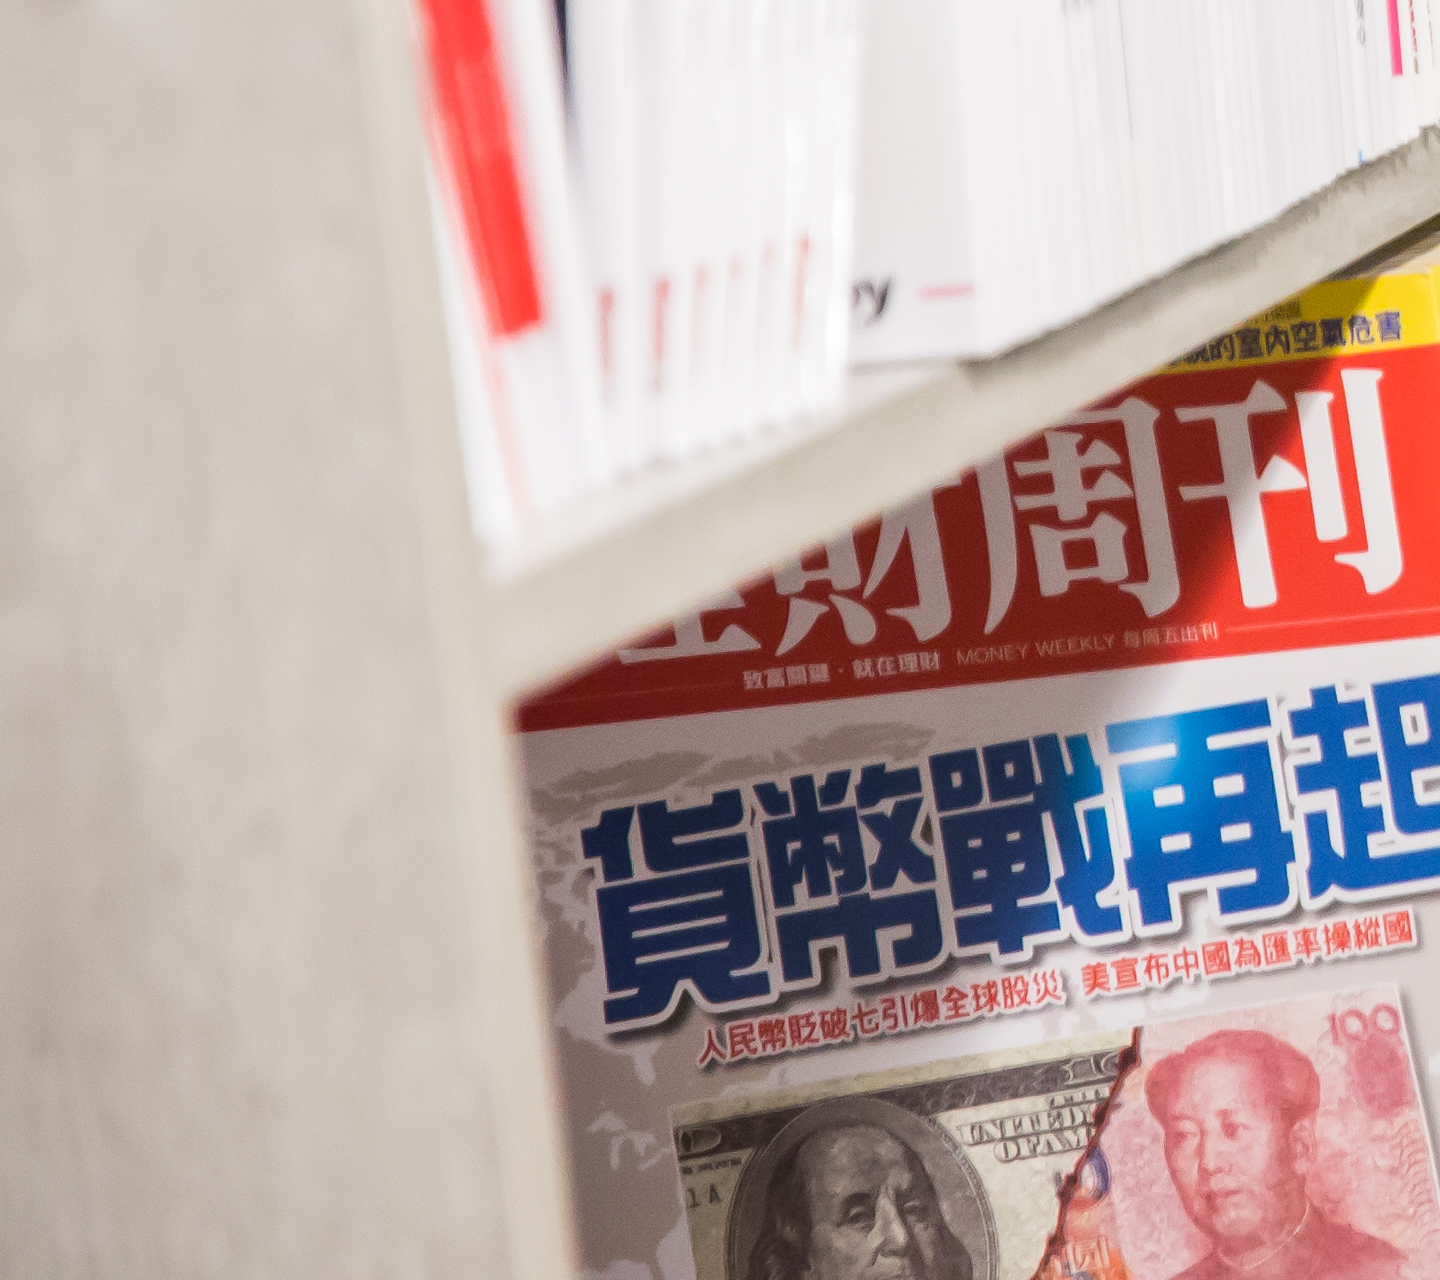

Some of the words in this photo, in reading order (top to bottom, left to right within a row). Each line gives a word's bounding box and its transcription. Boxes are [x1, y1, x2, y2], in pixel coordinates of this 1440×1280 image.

[956, 643, 1028, 667] MONEY
[1036, 632, 1116, 658] WEEKLY
[697, 968, 1064, 1066] 人民幣貶破七引爆全球股災
[1080, 910, 1414, 994] 美宣布中國為匯率操縱國
[1325, 1004, 1401, 1045] 100
